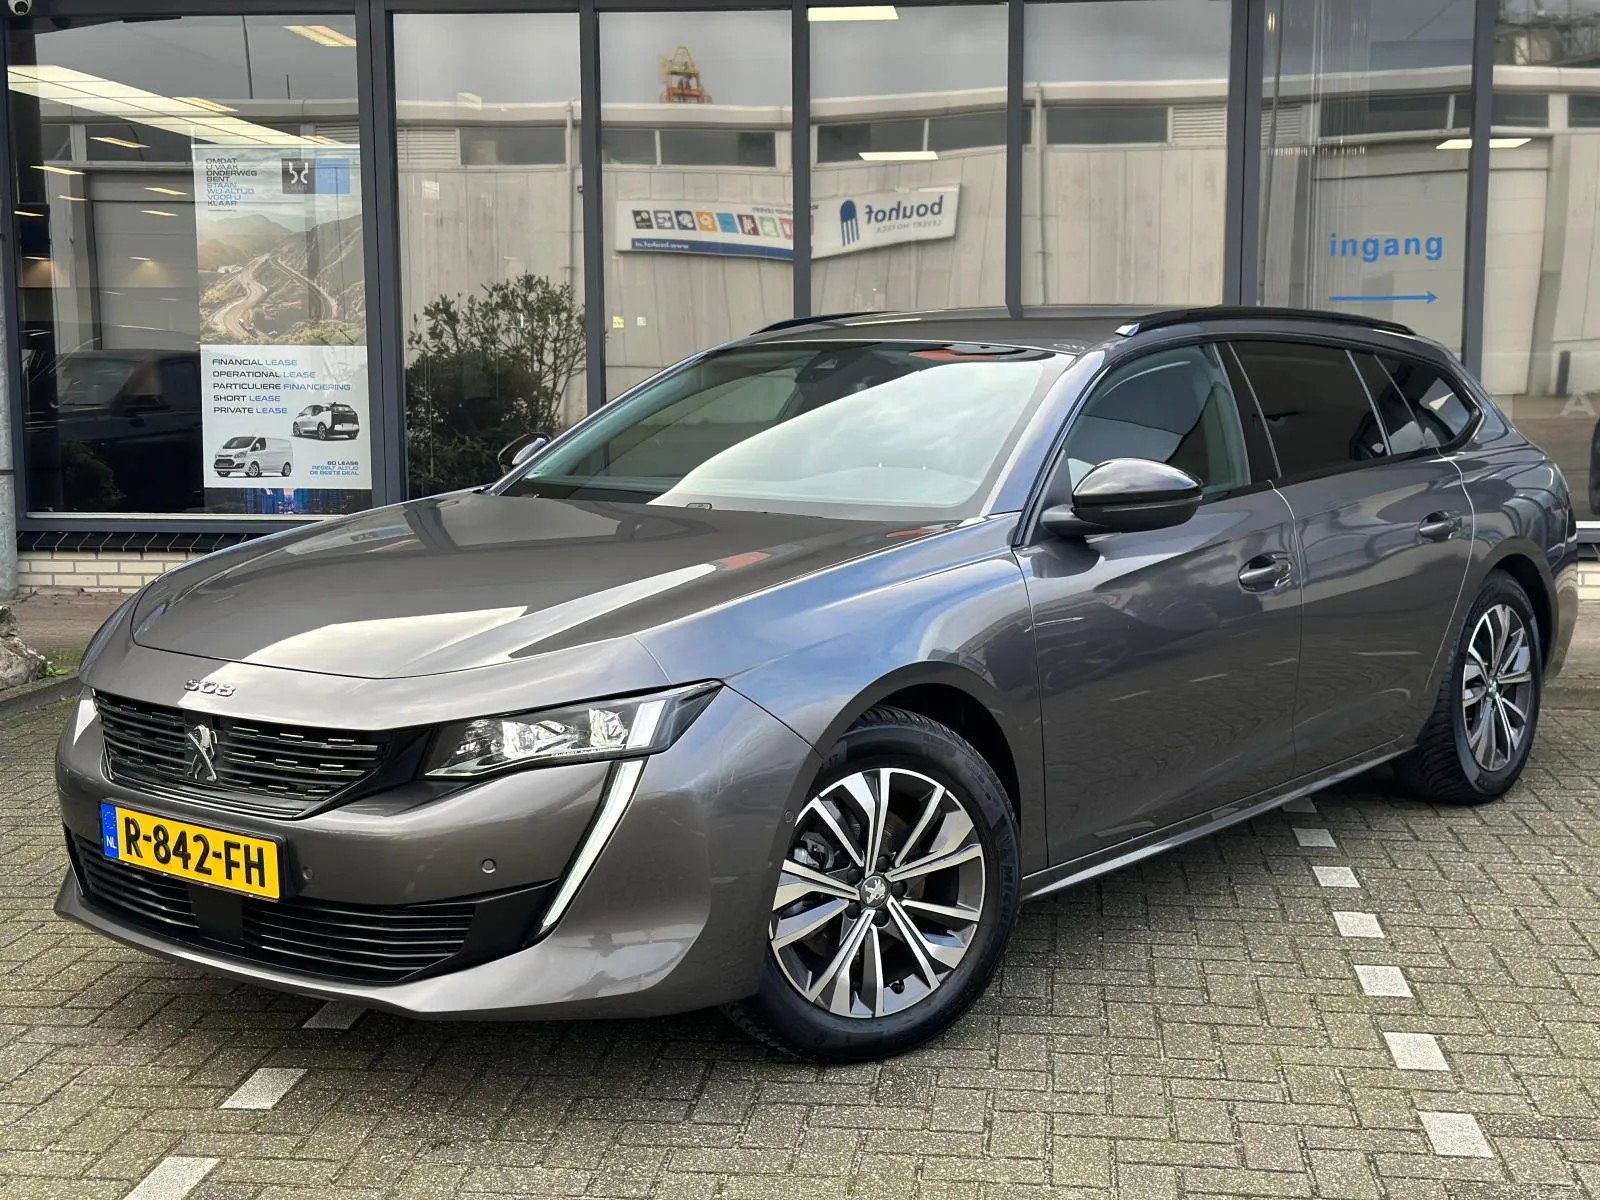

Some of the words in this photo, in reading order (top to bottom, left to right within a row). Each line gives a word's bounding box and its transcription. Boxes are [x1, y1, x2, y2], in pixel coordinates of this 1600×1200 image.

[1328, 232, 1443, 263] ingang
[212, 358, 264, 366] FINANCIAL
[213, 394, 247, 402] SHORT
[106, 835, 118, 849] NL
[124, 816, 266, 888] R-842-FH
